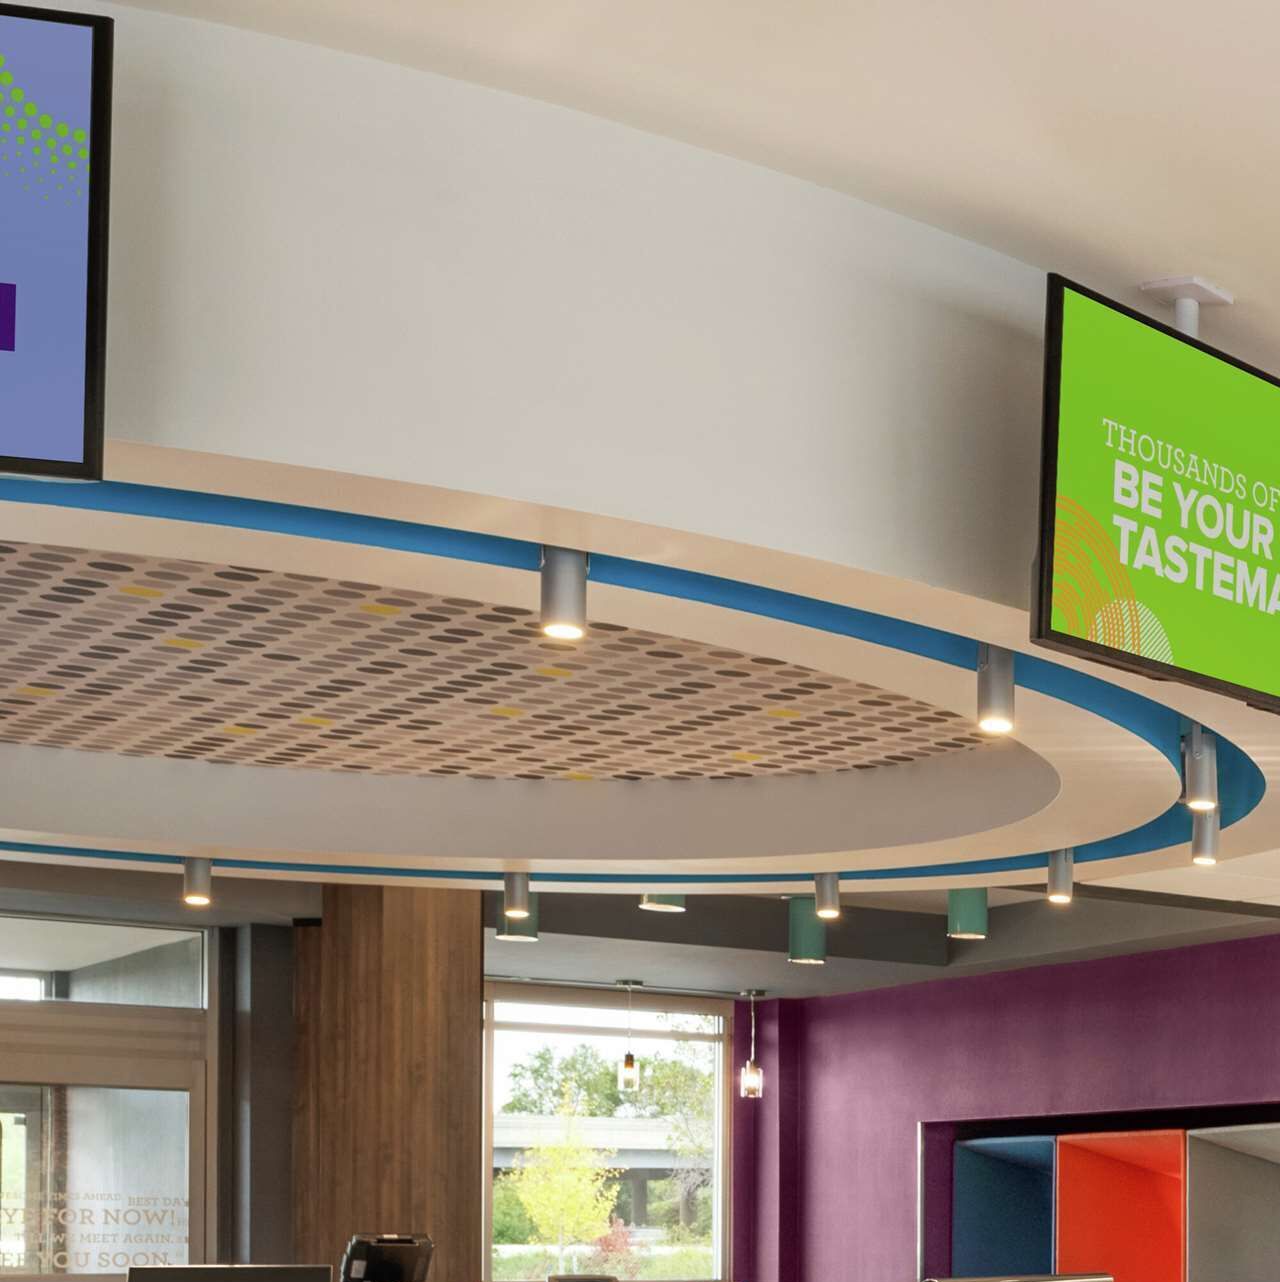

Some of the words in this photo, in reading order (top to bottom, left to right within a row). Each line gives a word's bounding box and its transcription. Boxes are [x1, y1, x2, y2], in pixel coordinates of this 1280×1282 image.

[1102, 417, 1247, 500] THOUSANDS
[1252, 481, 1280, 513] OF
[1113, 458, 1164, 519] BE
[1173, 481, 1275, 561] YOUR
[42, 1208, 95, 1225] FOR
[103, 1208, 176, 1226] NOW!
[80, 1233, 117, 1244] MEET
[35, 1253, 91, 1268] YOU
